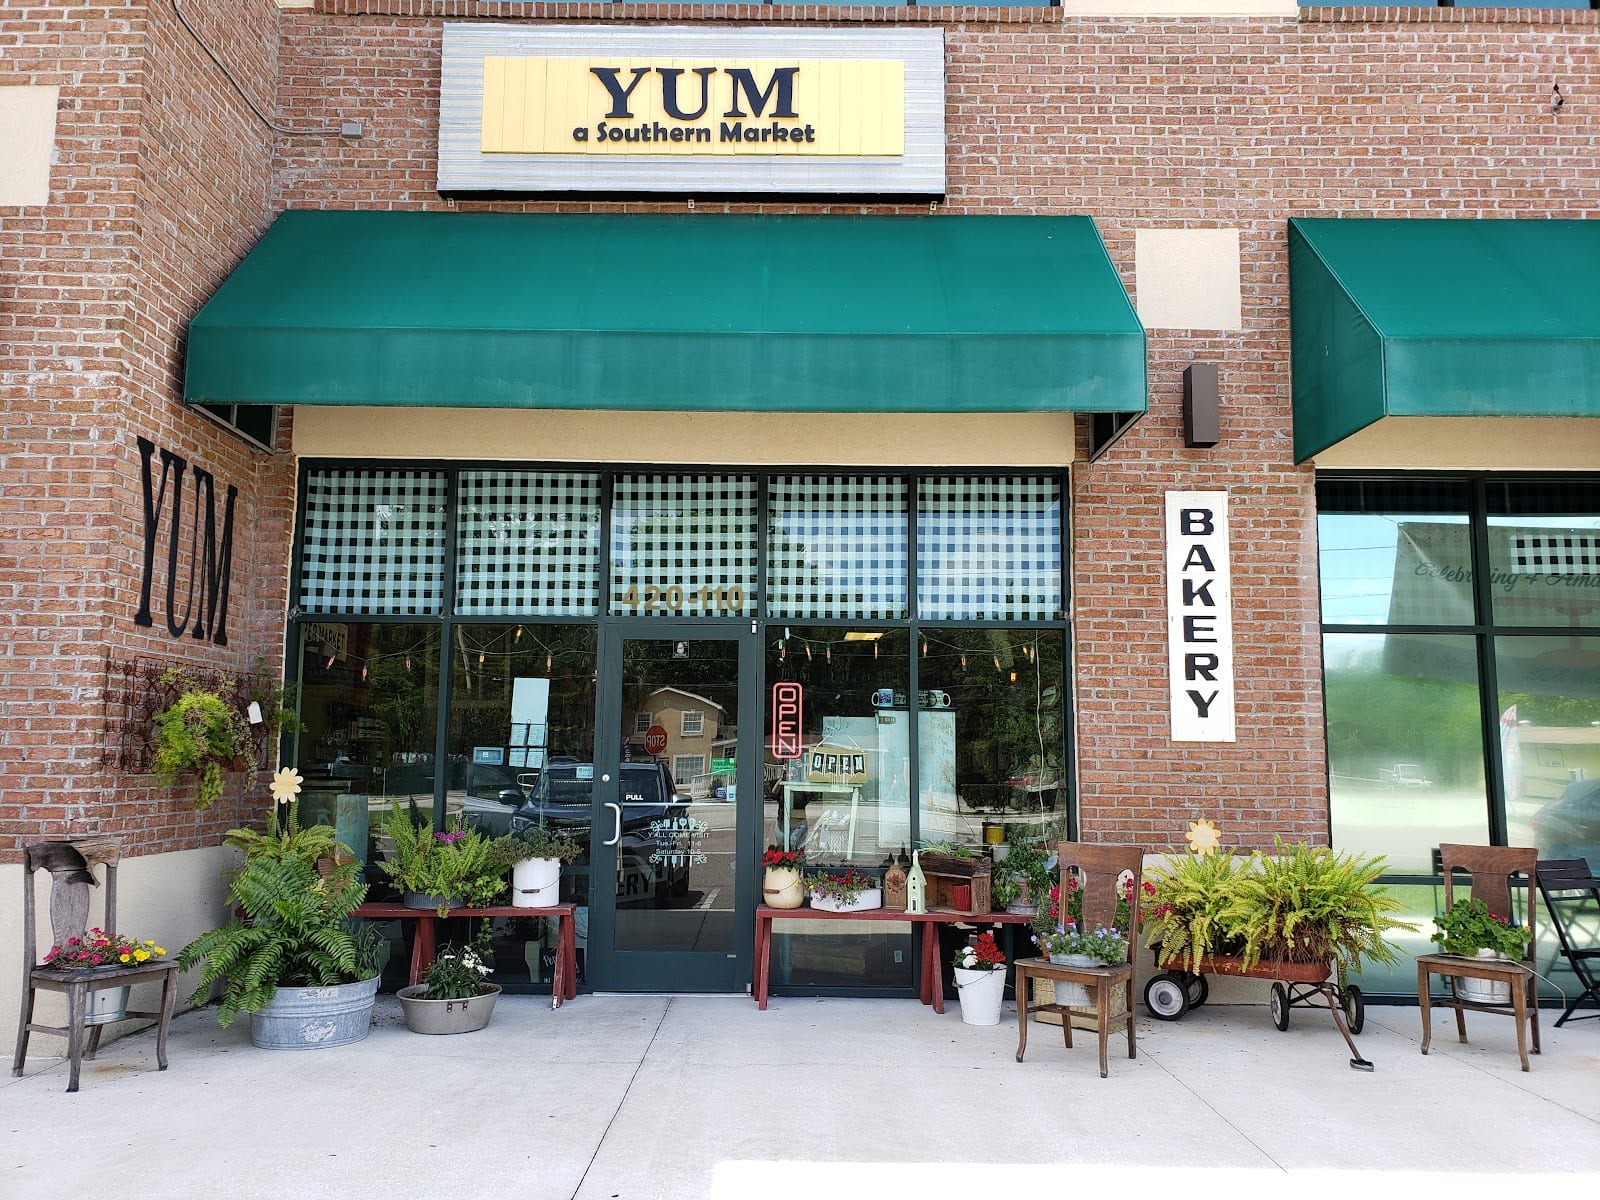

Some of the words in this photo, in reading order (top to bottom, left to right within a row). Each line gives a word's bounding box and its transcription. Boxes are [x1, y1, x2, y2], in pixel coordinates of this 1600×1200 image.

[590, 66, 801, 121] YUM
[572, 125, 589, 142] a
[597, 120, 711, 143] Southern
[720, 121, 815, 143] Market
[134, 435, 238, 646] YUM
[622, 585, 744, 611] 420-110
[1414, 561, 1520, 592] Celebring
[1180, 508, 1220, 718] BAKERY
[778, 687, 797, 754] OPEN
[814, 754, 864, 770] OPEN
